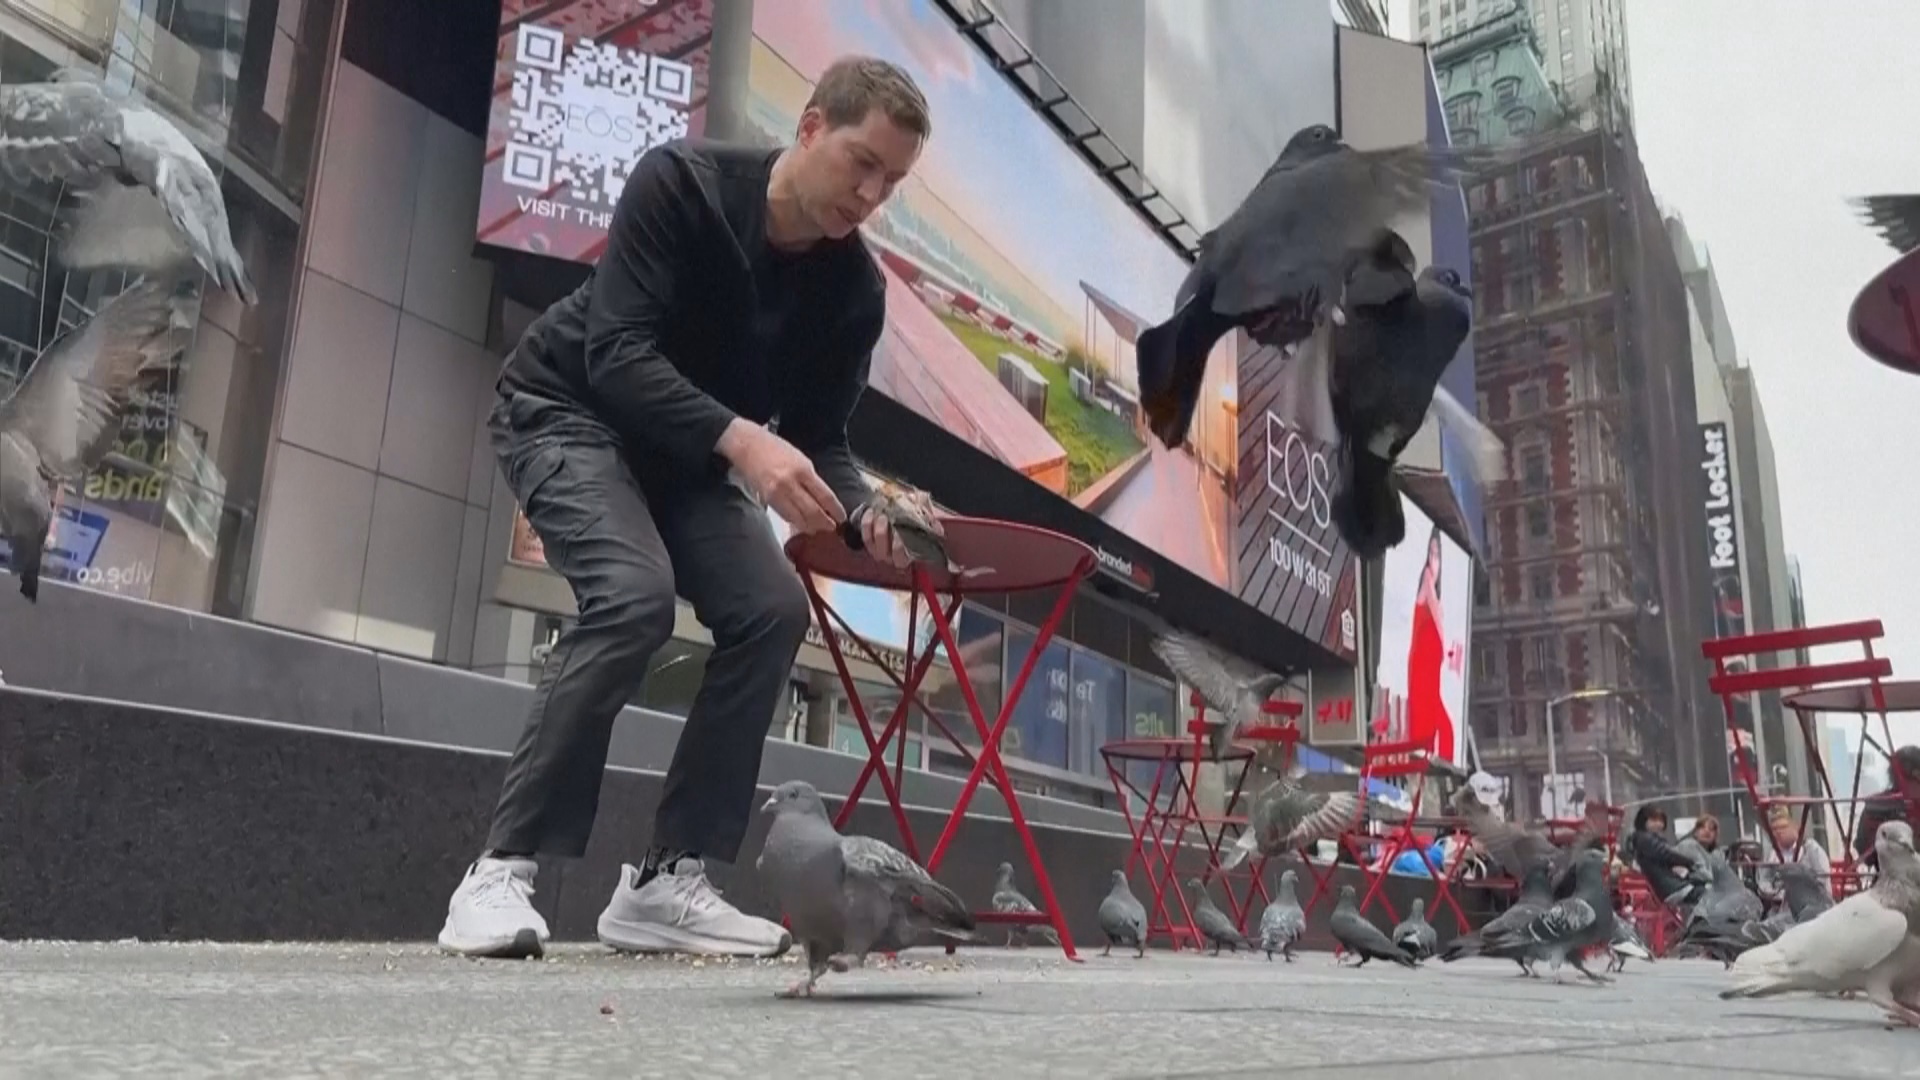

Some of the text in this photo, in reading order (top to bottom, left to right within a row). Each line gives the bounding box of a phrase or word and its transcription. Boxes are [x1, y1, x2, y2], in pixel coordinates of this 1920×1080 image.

[517, 195, 573, 220] VISIT
[1702, 428, 1735, 567] Foot Locker
[1098, 545, 1133, 577] branded
[1269, 536, 1292, 572] 100
[1292, 550, 1305, 582] W
